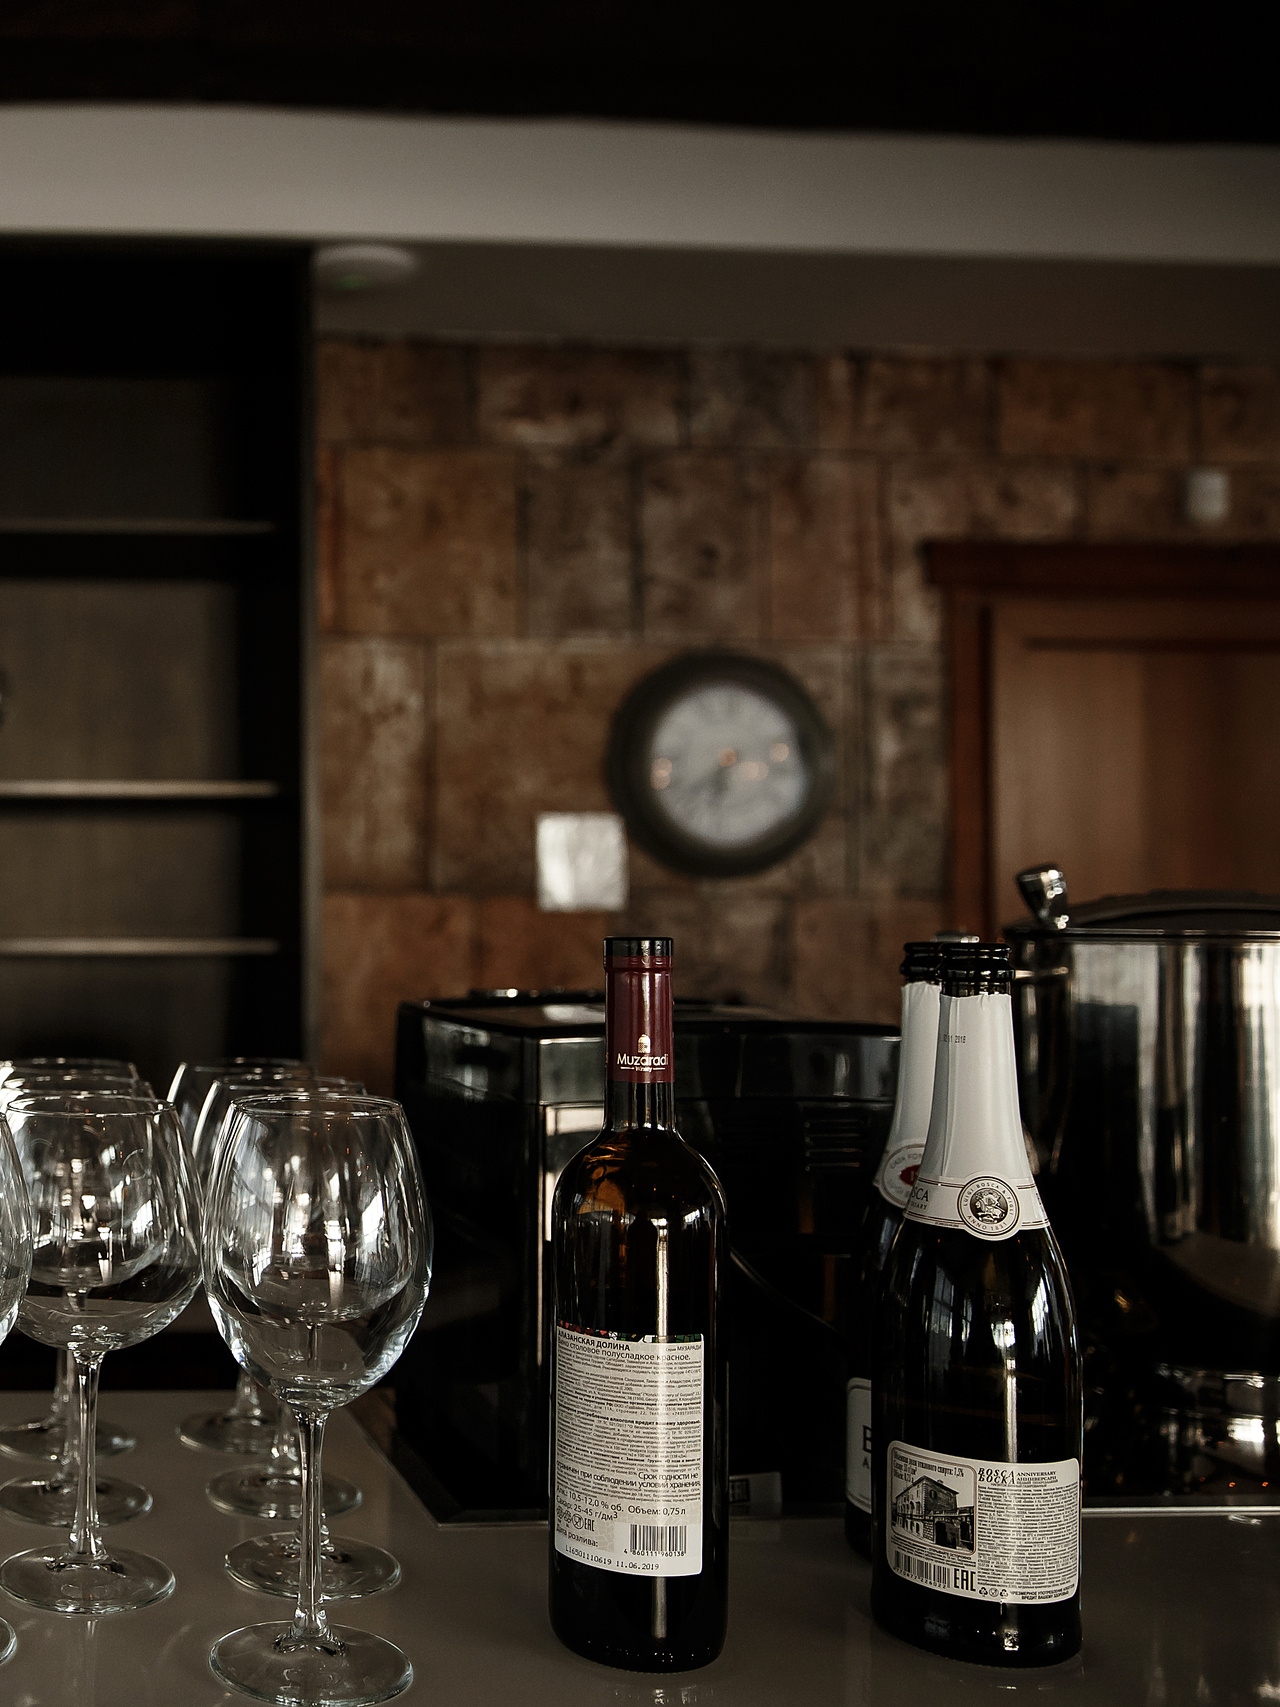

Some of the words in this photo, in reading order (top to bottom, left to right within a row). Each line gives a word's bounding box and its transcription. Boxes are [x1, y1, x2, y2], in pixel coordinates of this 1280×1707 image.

[616, 1053, 669, 1066] Muzaradi
[967, 1215, 987, 1230] ANNO
[569, 1340, 600, 1355] столовое
[601, 1350, 655, 1361] полусладкое
[596, 1341, 630, 1351] ДОЛИНА
[580, 1469, 592, 1480] при
[593, 1474, 637, 1487] соблюдении
[638, 1472, 657, 1481] Срок
[978, 1467, 1015, 1478] BOSCA
[569, 1490, 600, 1507] 10,5-12,0
[600, 1500, 609, 1509] %
[610, 1503, 624, 1512] об.
[628, 1505, 661, 1515] Объем:
[663, 1507, 680, 1516] 0,75
[573, 1503, 593, 1516] 25-45
[568, 1529, 599, 1548] розлива:
[616, 1560, 660, 1571] 11.06.2019
[953, 1568, 976, 1592] EAC
